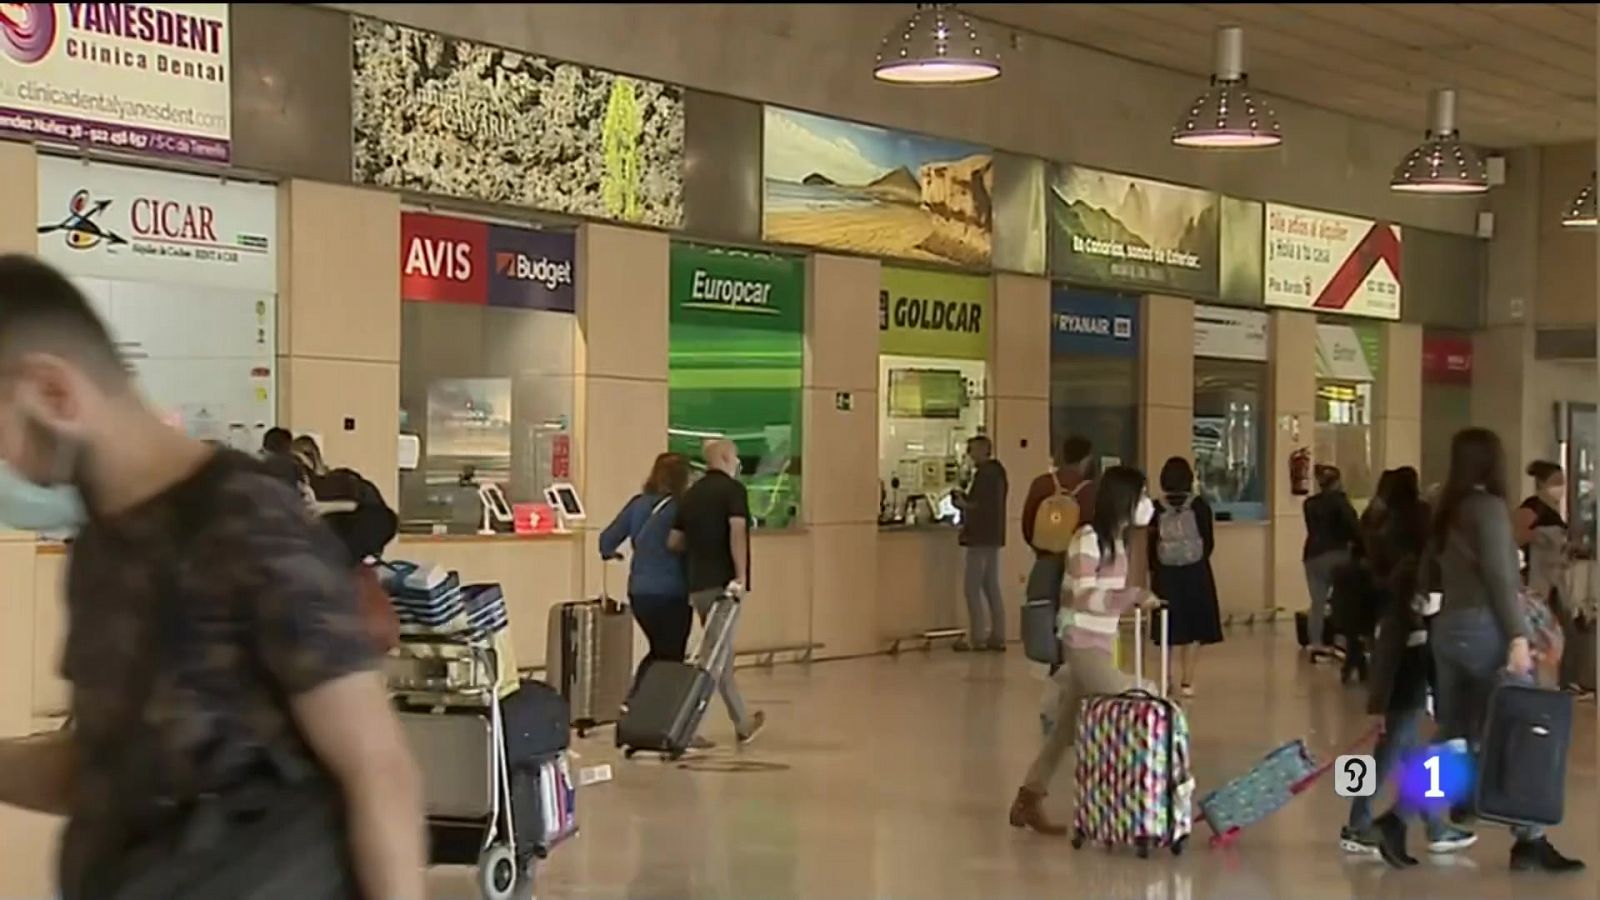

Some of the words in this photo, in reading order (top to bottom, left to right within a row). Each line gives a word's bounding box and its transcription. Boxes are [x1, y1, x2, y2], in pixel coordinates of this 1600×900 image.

[66, 3, 223, 54] YANESDENT
[156, 54, 224, 82] Dental
[130, 197, 216, 242] CICAR
[404, 237, 473, 281] AVIS
[517, 254, 572, 291] Budget
[692, 269, 772, 310] Europcar
[894, 297, 982, 334] GOLDCAR
[1058, 314, 1110, 335] RYANAIR
